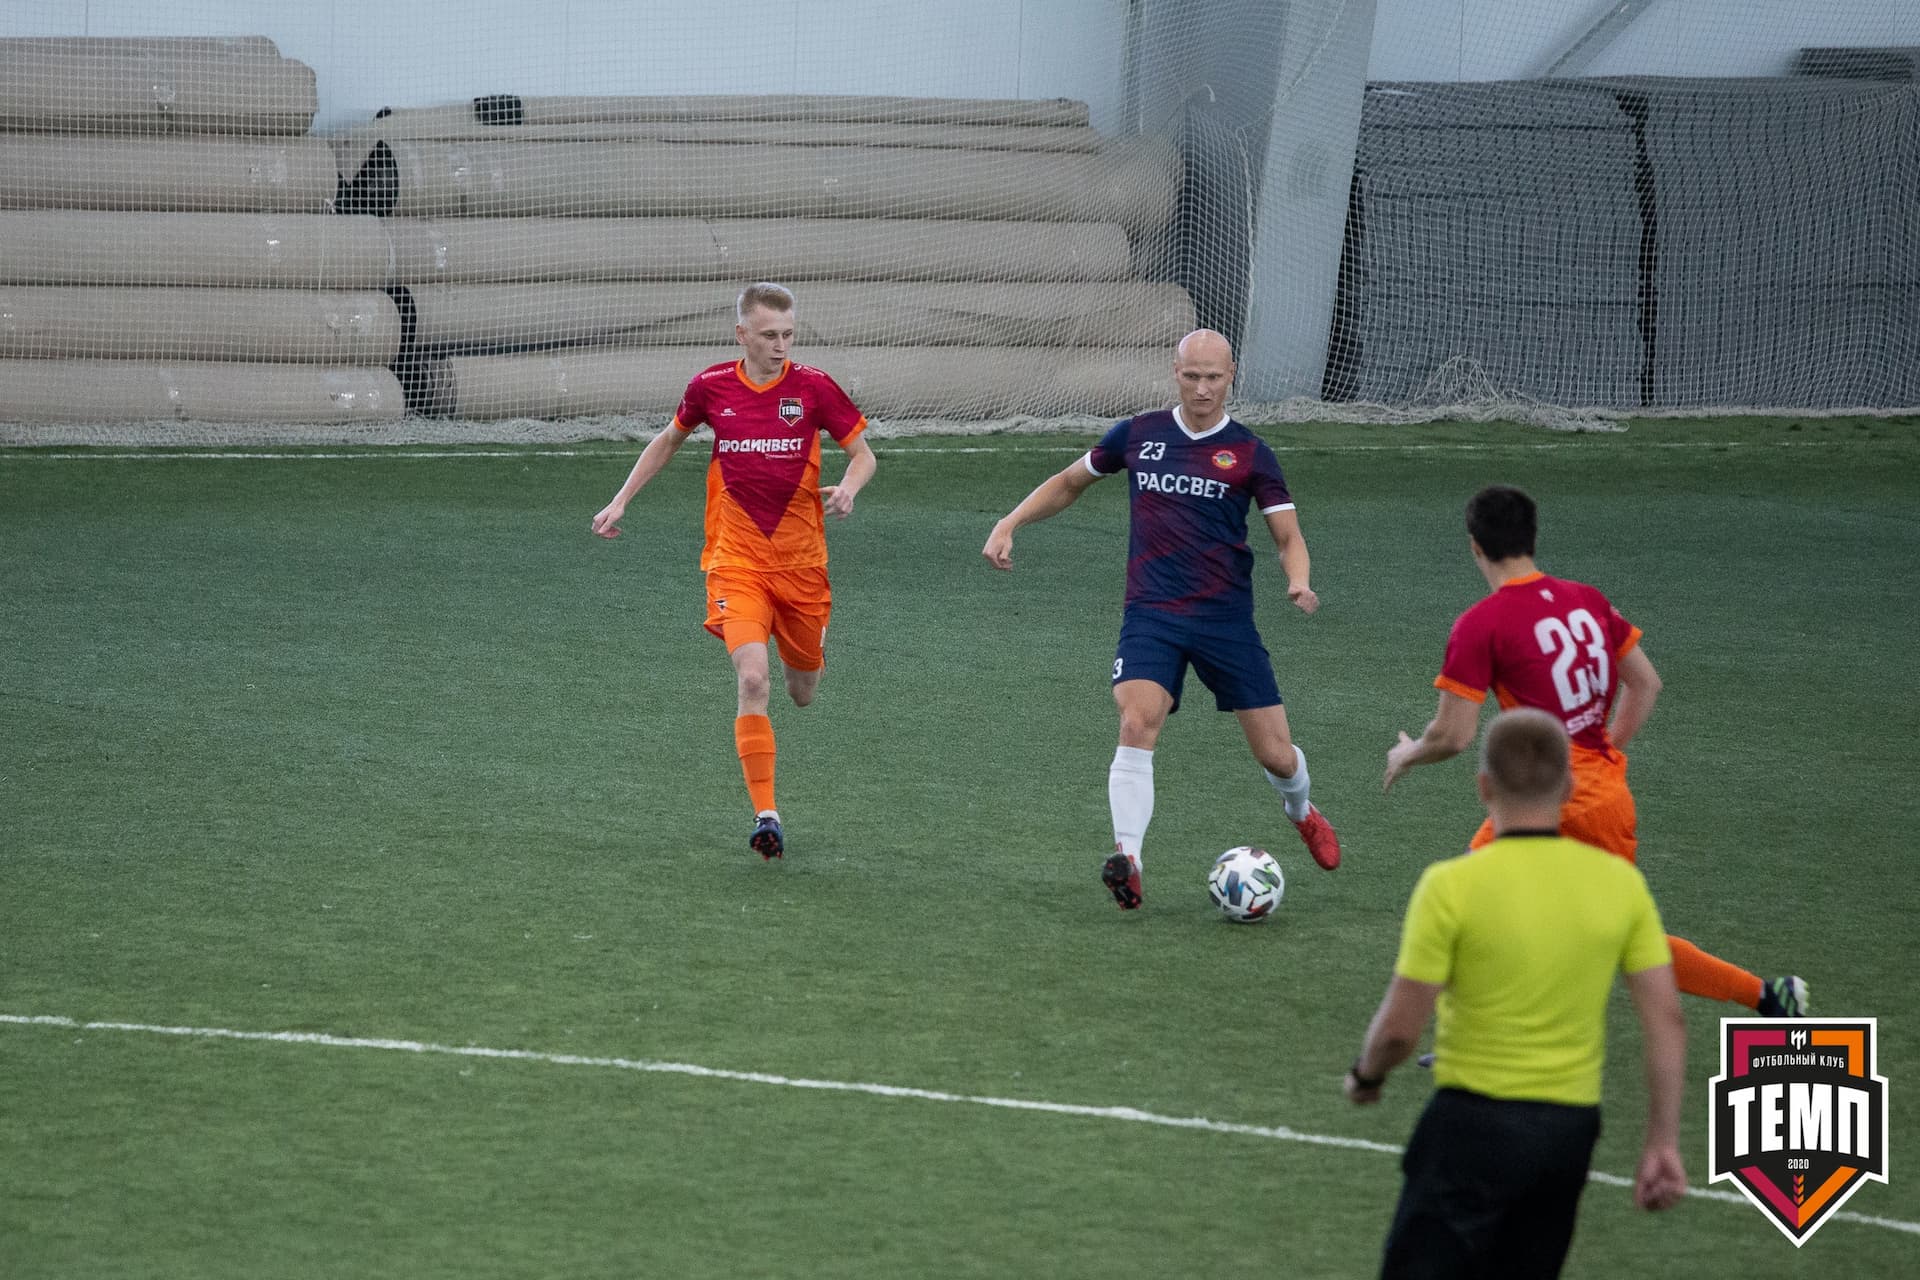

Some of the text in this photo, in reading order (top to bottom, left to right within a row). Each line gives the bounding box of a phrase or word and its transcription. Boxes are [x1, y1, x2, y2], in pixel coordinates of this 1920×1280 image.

[781, 405, 801, 416] ТЕМП
[719, 438, 804, 453] ПРОДИНВЕСТ
[1138, 440, 1167, 461] 23
[1136, 471, 1230, 500] РАССВЕТ
[1534, 608, 1609, 712] 23
